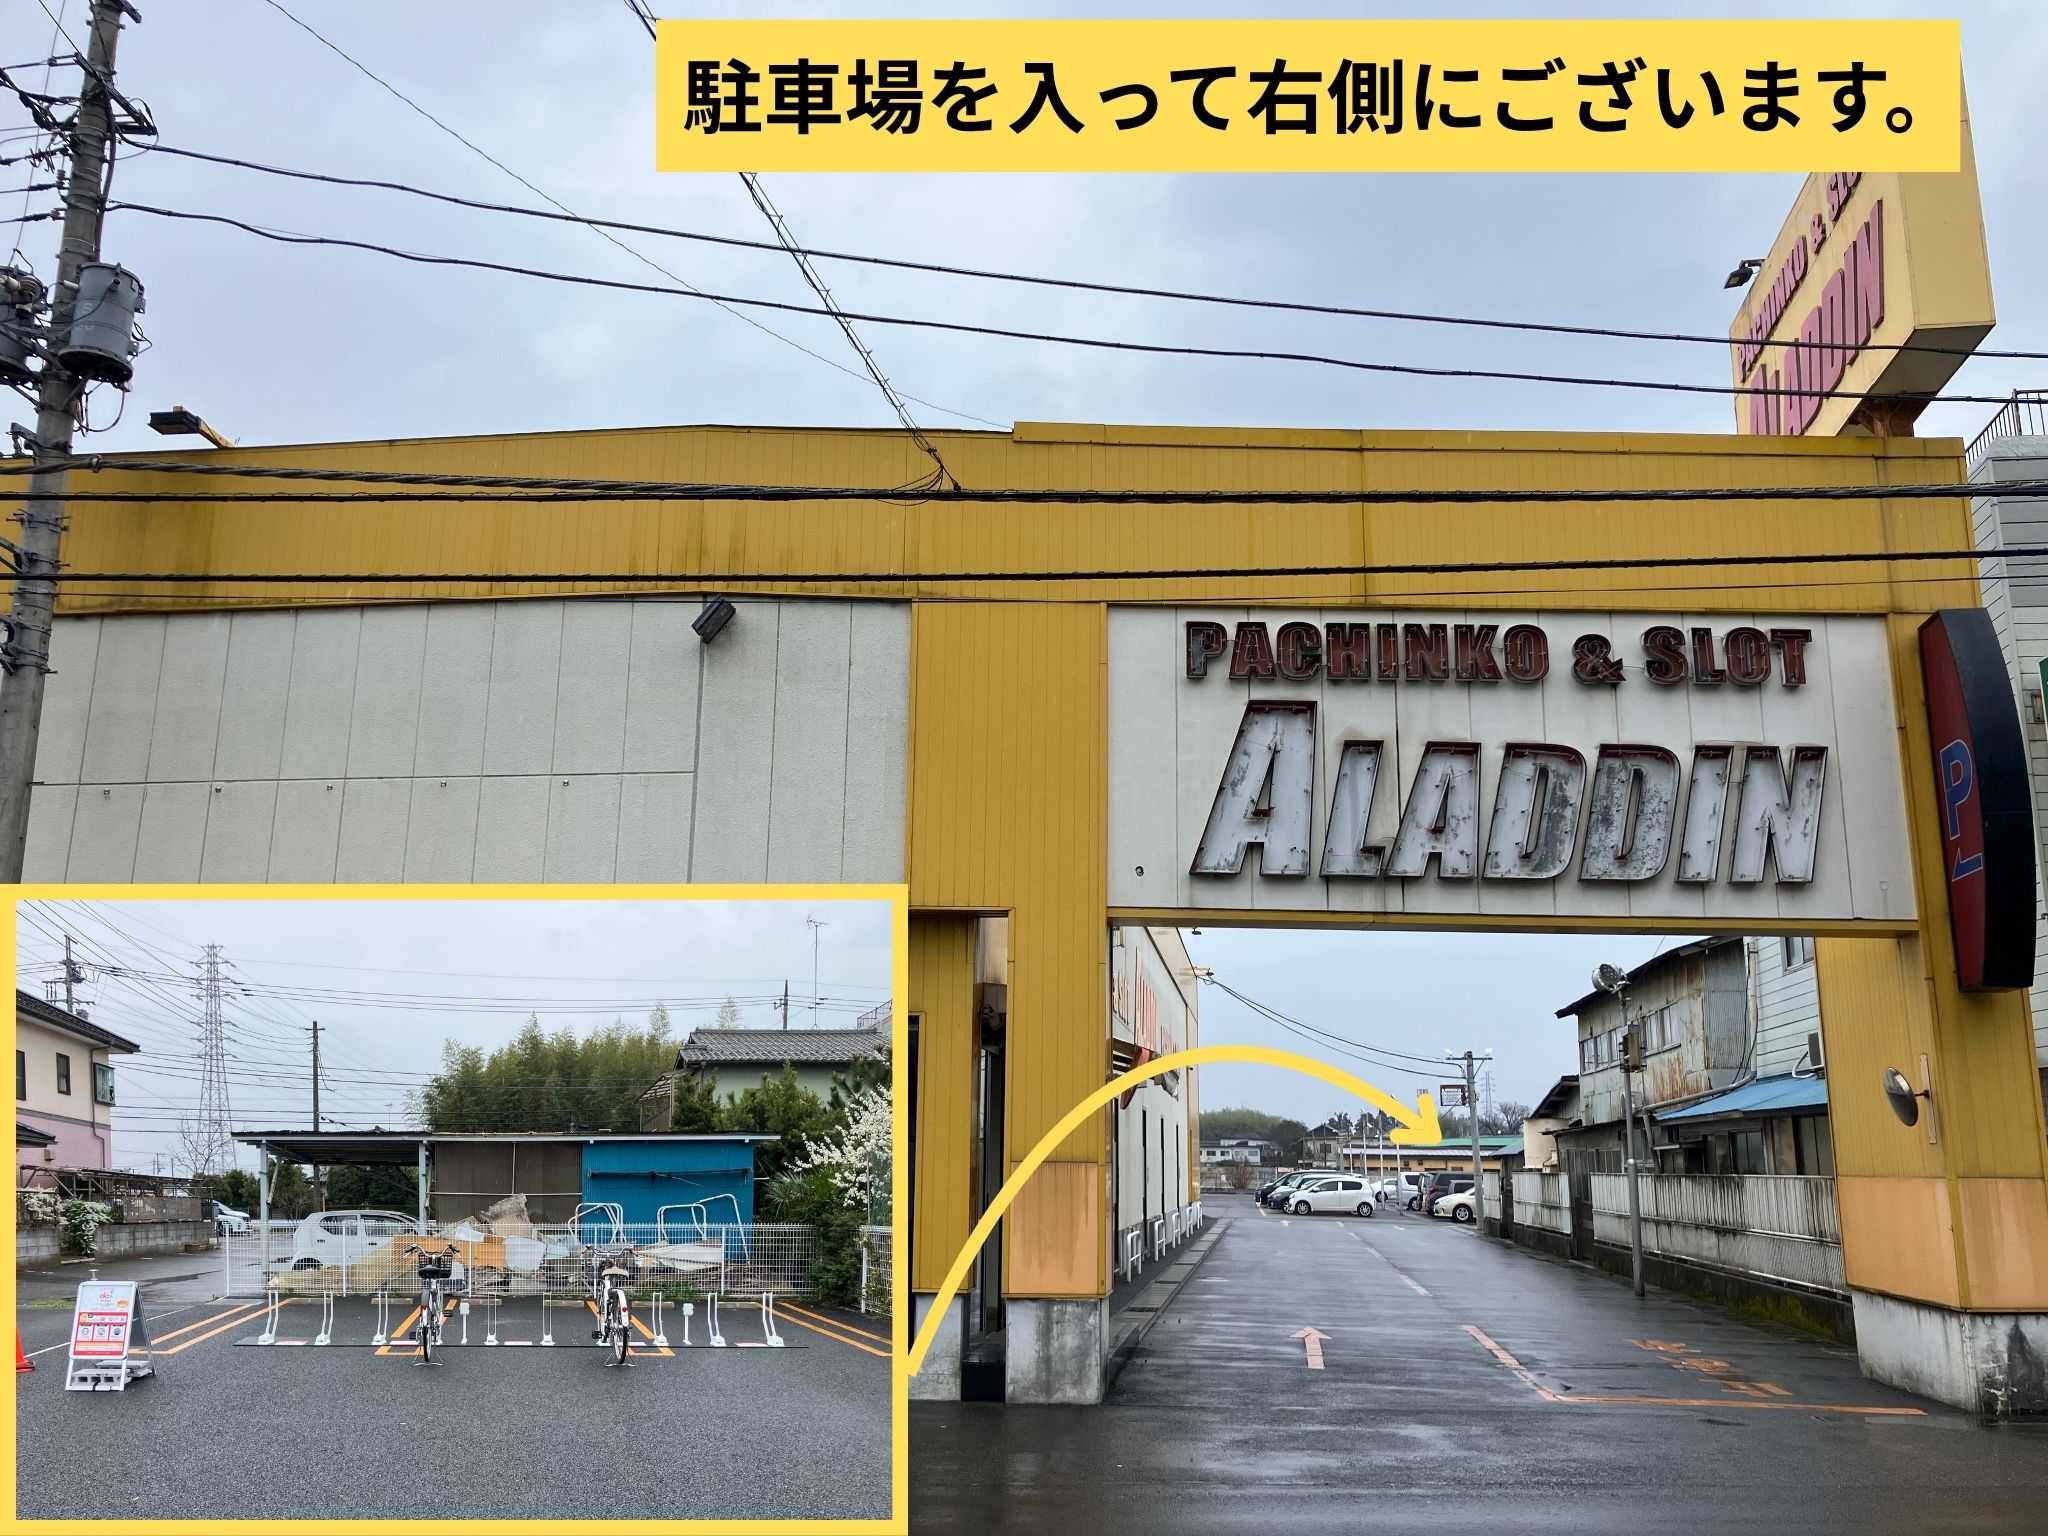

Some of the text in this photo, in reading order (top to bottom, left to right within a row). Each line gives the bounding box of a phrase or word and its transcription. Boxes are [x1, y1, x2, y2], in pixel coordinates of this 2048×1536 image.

[1810, 212, 1827, 255] &
[1826, 171, 1863, 224] SL
[1186, 621, 1813, 687] PACHINKO & SLOT
[1188, 699, 1829, 885] ALADDIN
[1939, 738, 1974, 841] P
